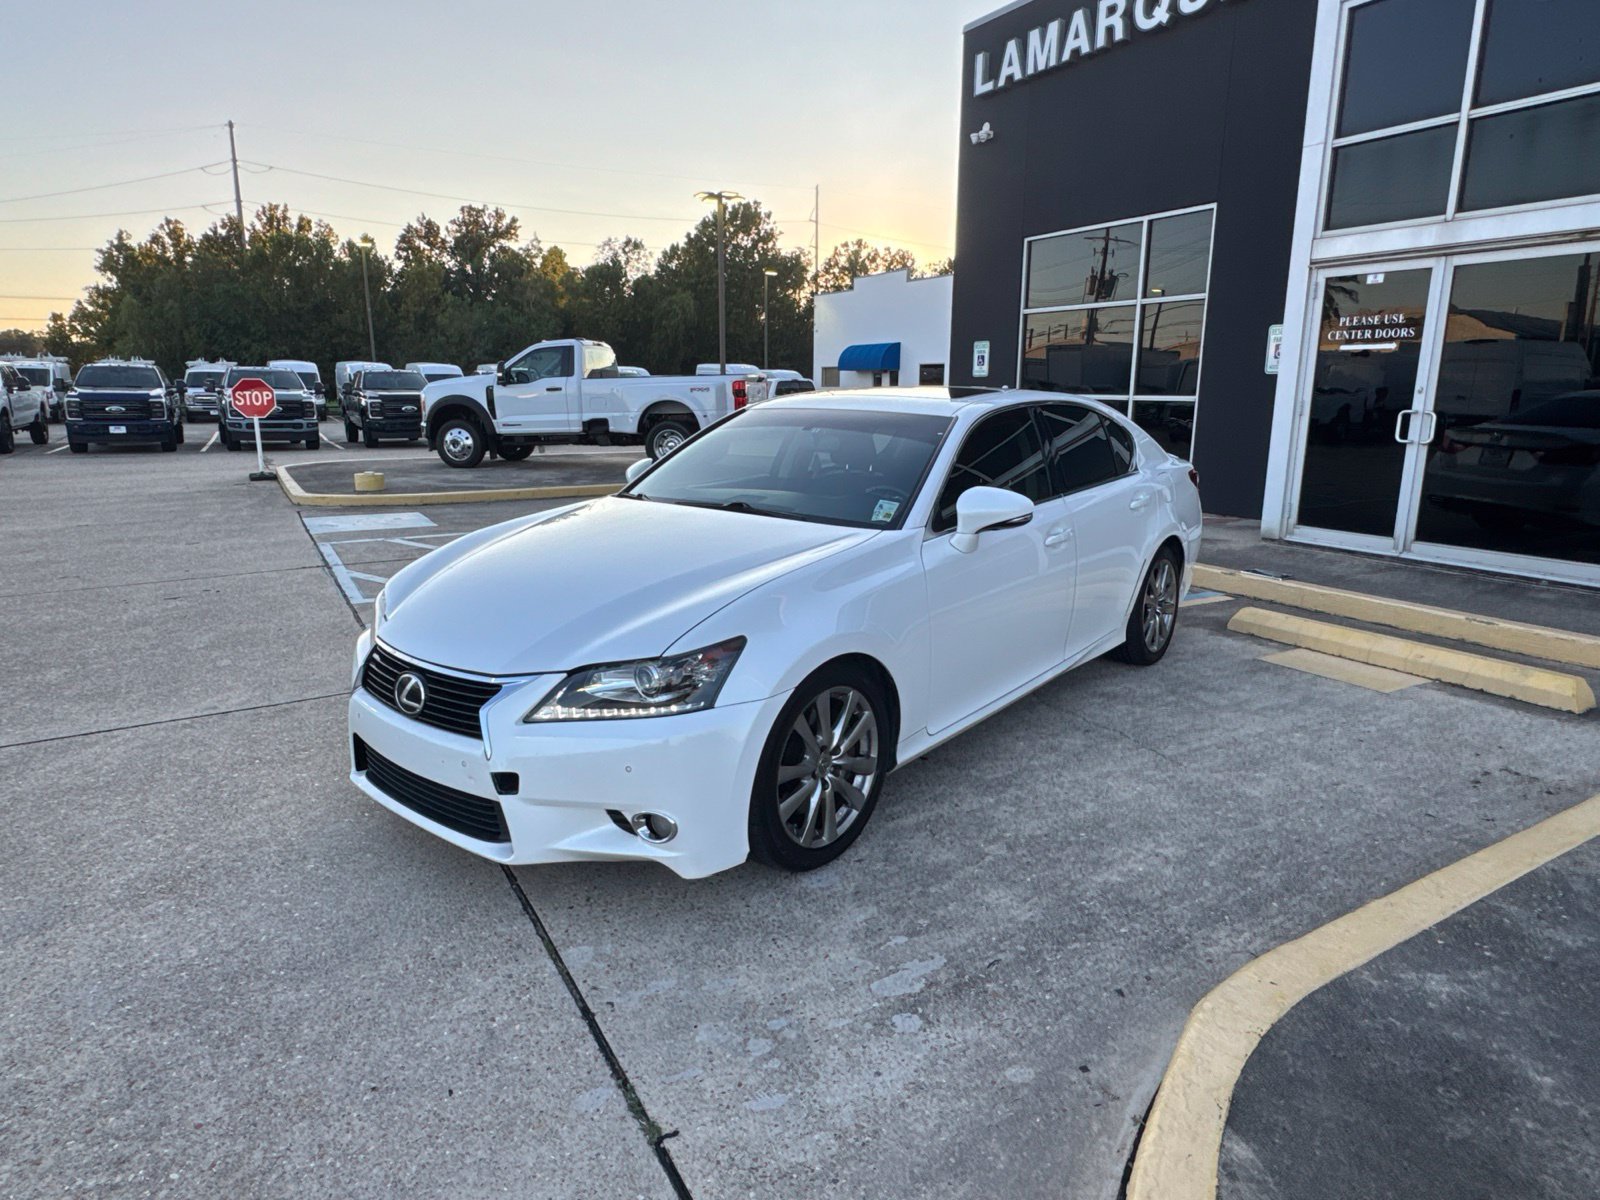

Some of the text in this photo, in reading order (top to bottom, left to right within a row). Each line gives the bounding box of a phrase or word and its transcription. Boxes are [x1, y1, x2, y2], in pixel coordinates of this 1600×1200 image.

[973, 0, 1208, 97] LAMARQ
[1339, 313, 1406, 326] PLEASE USE
[1328, 327, 1416, 340] CENTER DOORS
[235, 391, 273, 406] STOP
